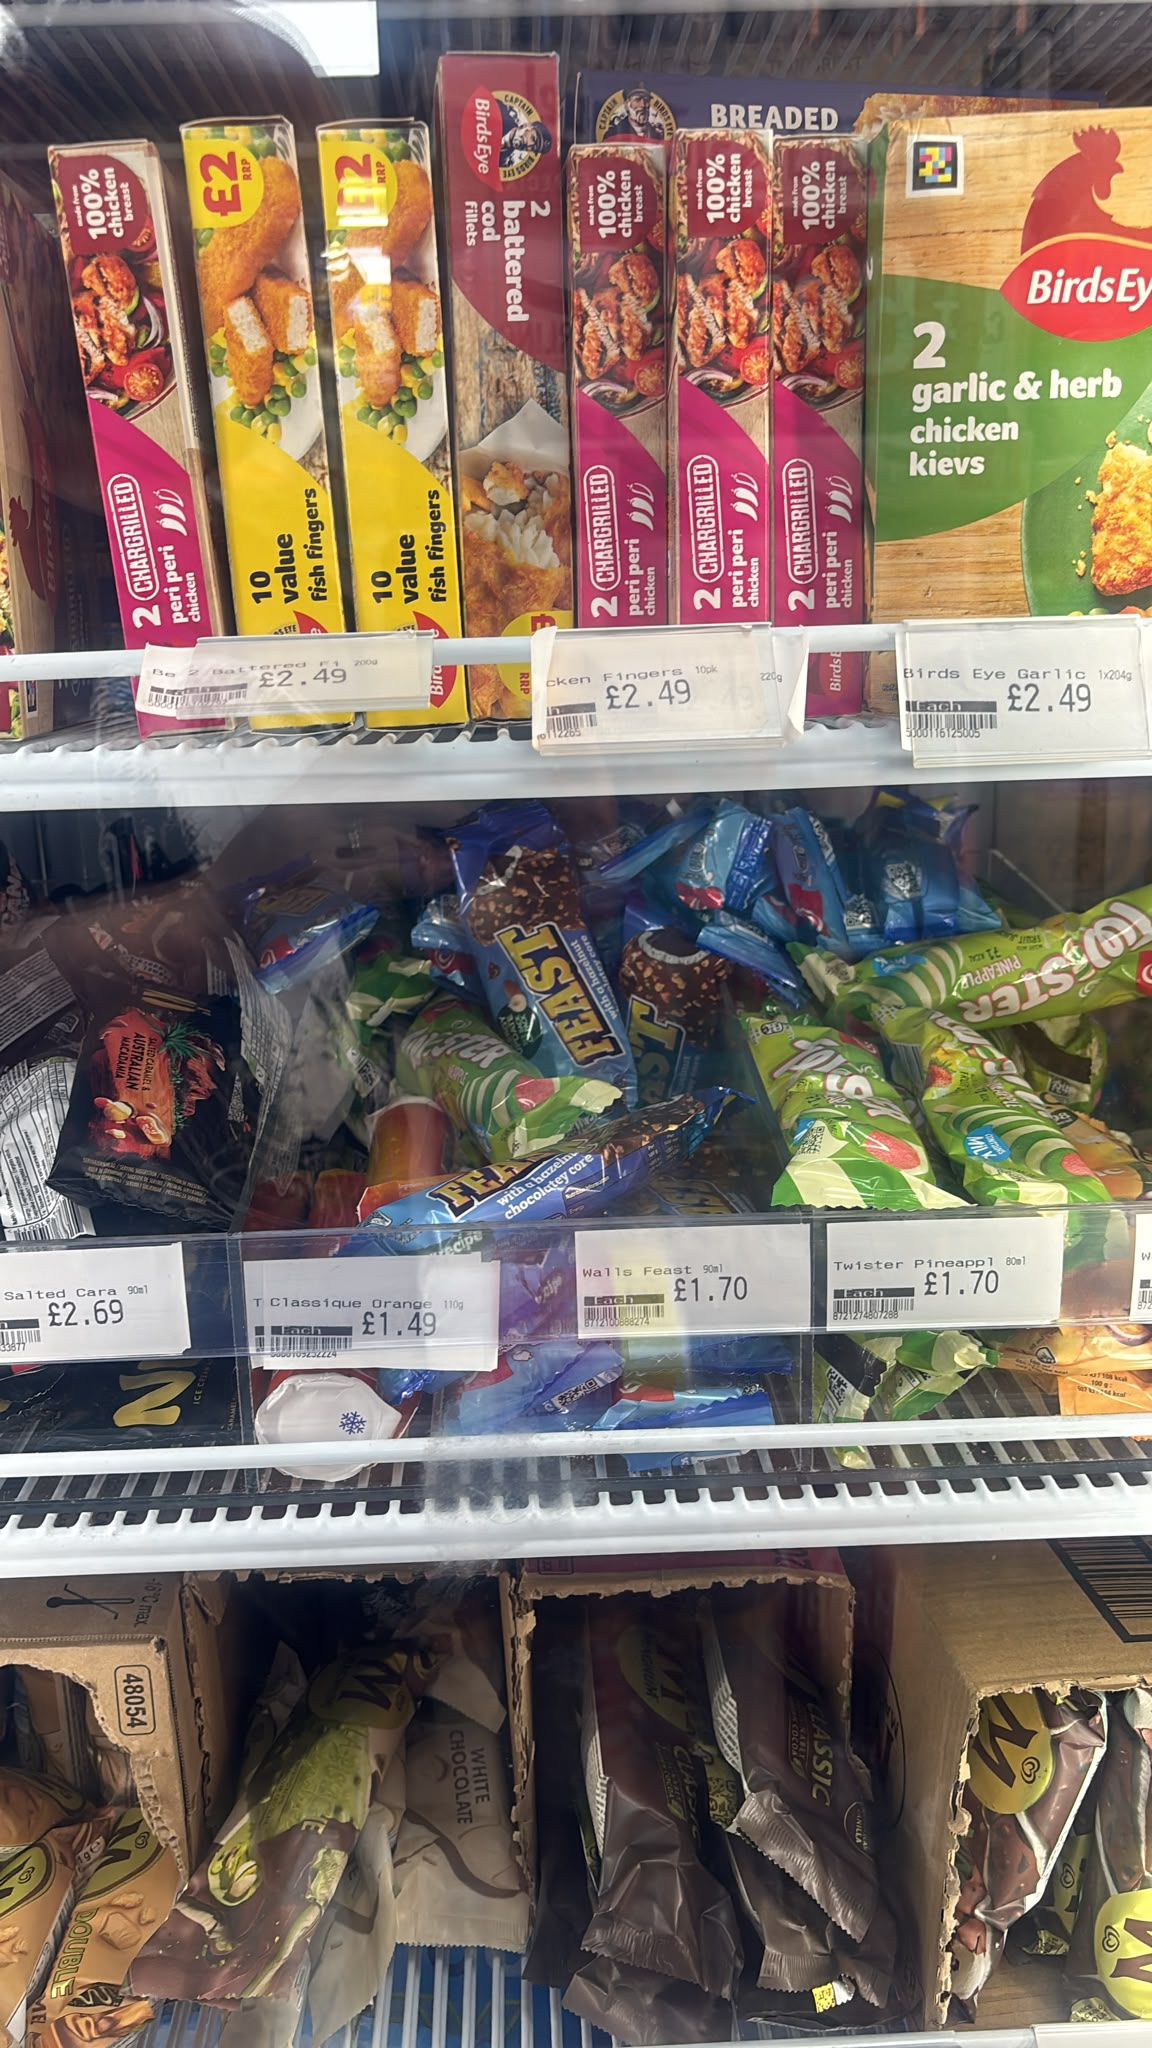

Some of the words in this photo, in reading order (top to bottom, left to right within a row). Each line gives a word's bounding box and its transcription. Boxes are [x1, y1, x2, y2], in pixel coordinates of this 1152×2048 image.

[474, 98, 492, 175] BirdsEye
[710, 104, 839, 131] BREADED
[200, 151, 242, 217] £2
[241, 158, 252, 181] RRP
[376, 161, 386, 185] RRP
[706, 153, 726, 224] 100%
[727, 153, 741, 224] chicken
[743, 168, 753, 208] breast
[80, 168, 107, 240] 100%
[104, 167, 124, 238] chicken
[123, 182, 134, 222] breast
[530, 200, 551, 217] 2
[598, 170, 616, 239] 100%
[617, 169, 632, 238] chicken
[634, 184, 643, 224] breast
[802, 161, 821, 230] 100%
[821, 160, 836, 230] chicken
[837, 175, 847, 215] breast
[465, 201, 478, 247] fillets
[481, 201, 500, 242] cod
[503, 200, 530, 322] battered
[1027, 265, 1152, 312] BirdsEy
[913, 321, 946, 370] 2
[912, 371, 1006, 413] garlic
[1013, 371, 1043, 400] &
[1050, 367, 1122, 399] herb
[910, 416, 1019, 444] chicken
[909, 450, 985, 477] kievs
[114, 481, 154, 595] CHARGRILLED
[303, 488, 325, 560] fingers
[425, 489, 446, 560] fingers
[590, 473, 615, 583] CHARGRILLED
[693, 463, 718, 575] CHARGRILLED
[788, 466, 812, 576] CHARGRILLED
[157, 545, 184, 584] peri
[624, 538, 643, 576] peri
[728, 529, 747, 567] peri
[822, 531, 841, 569] peri
[250, 571, 272, 604] 10
[274, 533, 299, 604] value
[308, 565, 328, 602] fish
[371, 571, 393, 604] 10
[395, 534, 418, 604] value
[429, 566, 447, 602] fish
[747, 557, 759, 608] chicken
[841, 558, 853, 608] chicken
[164, 587, 189, 625] peri
[185, 571, 201, 623] chicken
[590, 596, 618, 618] 2
[624, 579, 644, 616] peri
[644, 566, 655, 616] chicken
[693, 587, 720, 610] 2
[728, 570, 747, 608] peri
[788, 589, 815, 611] 2
[822, 572, 841, 608] peri
[132, 604, 162, 629] 2
[259, 668, 347, 688] £2.49
[519, 672, 529, 695] RRP
[603, 666, 683, 682] Fingers
[903, 668, 960, 680] Birds
[973, 669, 1006, 681] Eye
[1018, 668, 1086, 680] Garlic
[606, 679, 691, 711] £2.49
[1007, 683, 1092, 713] £2.49
[498, 926, 616, 1063] FEAST
[115, 1036, 130, 1079] MACADAMIA
[126, 1032, 146, 1091] AUSTRALIAN
[496, 1185, 524, 1206] with
[504, 1172, 570, 1220] chocolatey
[569, 1153, 594, 1176] core
[583, 1267, 633, 1277] Walls
[643, 1266, 692, 1276] Feast
[833, 1260, 904, 1271] Twister
[914, 1257, 994, 1269] Pineappl
[924, 1270, 999, 1296] £1.70
[4, 1289, 66, 1301] Salted
[76, 1288, 117, 1298] Cara
[253, 1299, 262, 1308] T
[270, 1298, 362, 1309] Classique
[372, 1299, 432, 1311] Orange
[673, 1276, 748, 1302] £1.70
[48, 1299, 124, 1327] £2.69
[362, 1311, 437, 1337] £1.49
[122, 1673, 147, 1728] 48054
[449, 1729, 473, 1824] CHOCOLATE
[471, 1748, 490, 1804] WHITE
[51, 1907, 100, 1998] DOUBLE
